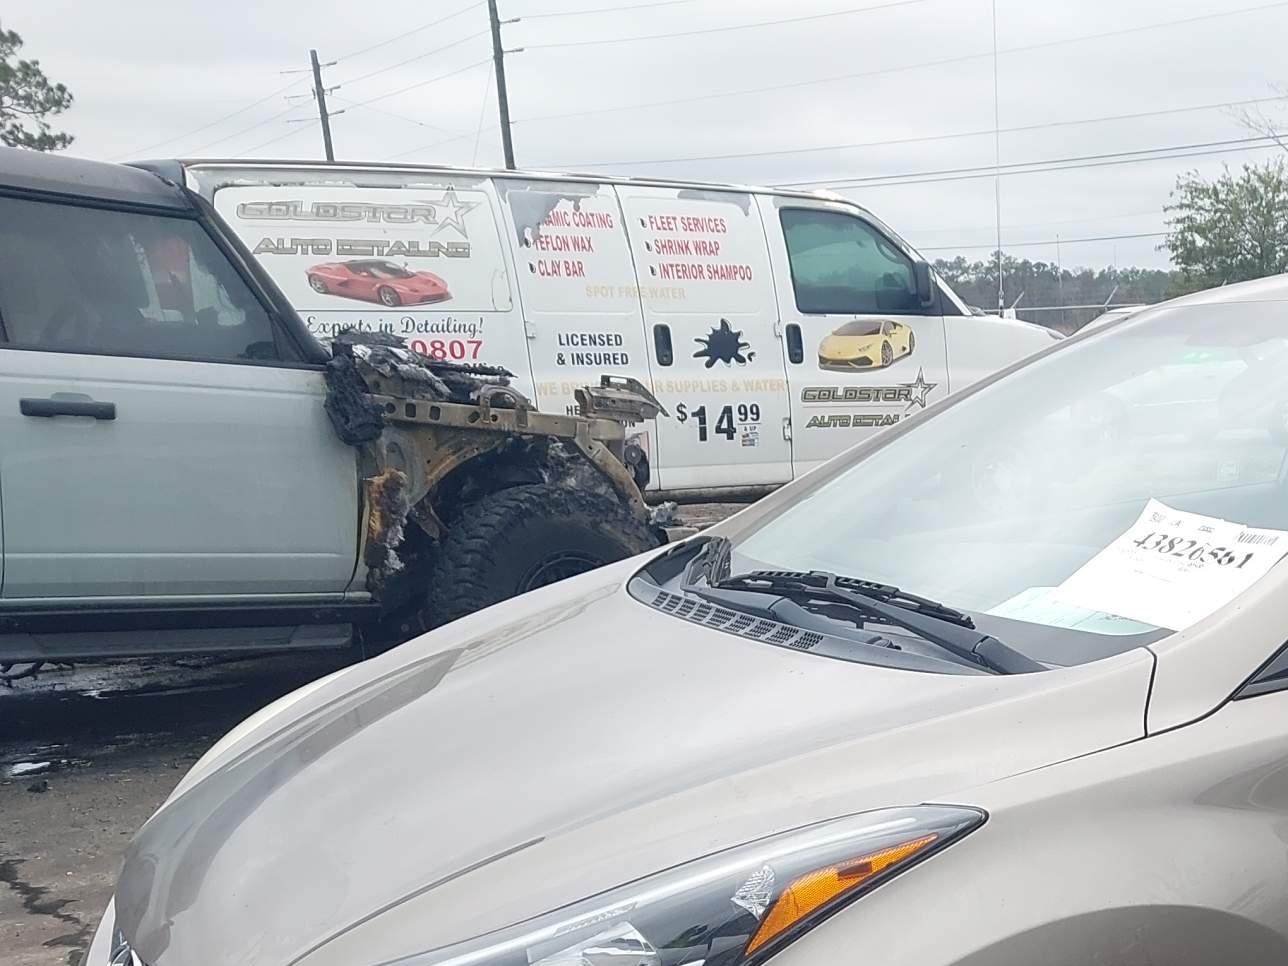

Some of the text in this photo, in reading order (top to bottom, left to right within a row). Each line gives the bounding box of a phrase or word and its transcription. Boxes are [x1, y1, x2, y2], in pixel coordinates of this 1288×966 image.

[572, 212, 614, 229] COATING
[648, 215, 727, 234] FLEET SERVICES
[253, 237, 332, 256] AUTO
[570, 235, 594, 252] WAX
[653, 239, 720, 256] SHRINK WRAP
[538, 260, 585, 278] CLAY BAR
[658, 263, 752, 281] INTERIOR SHAMPOO
[585, 286, 614, 299] SPOT
[650, 287, 687, 300] WATER
[378, 318, 396, 334] in
[400, 316, 484, 338] Detailing!
[558, 333, 623, 347] LICENSED
[556, 353, 629, 366] & INSURED
[668, 379, 728, 393] SUPPLIES
[731, 380, 741, 392] &
[742, 379, 785, 392] WATER
[805, 415, 851, 428] AUTO
[1133, 532, 1254, 569] 43826561
